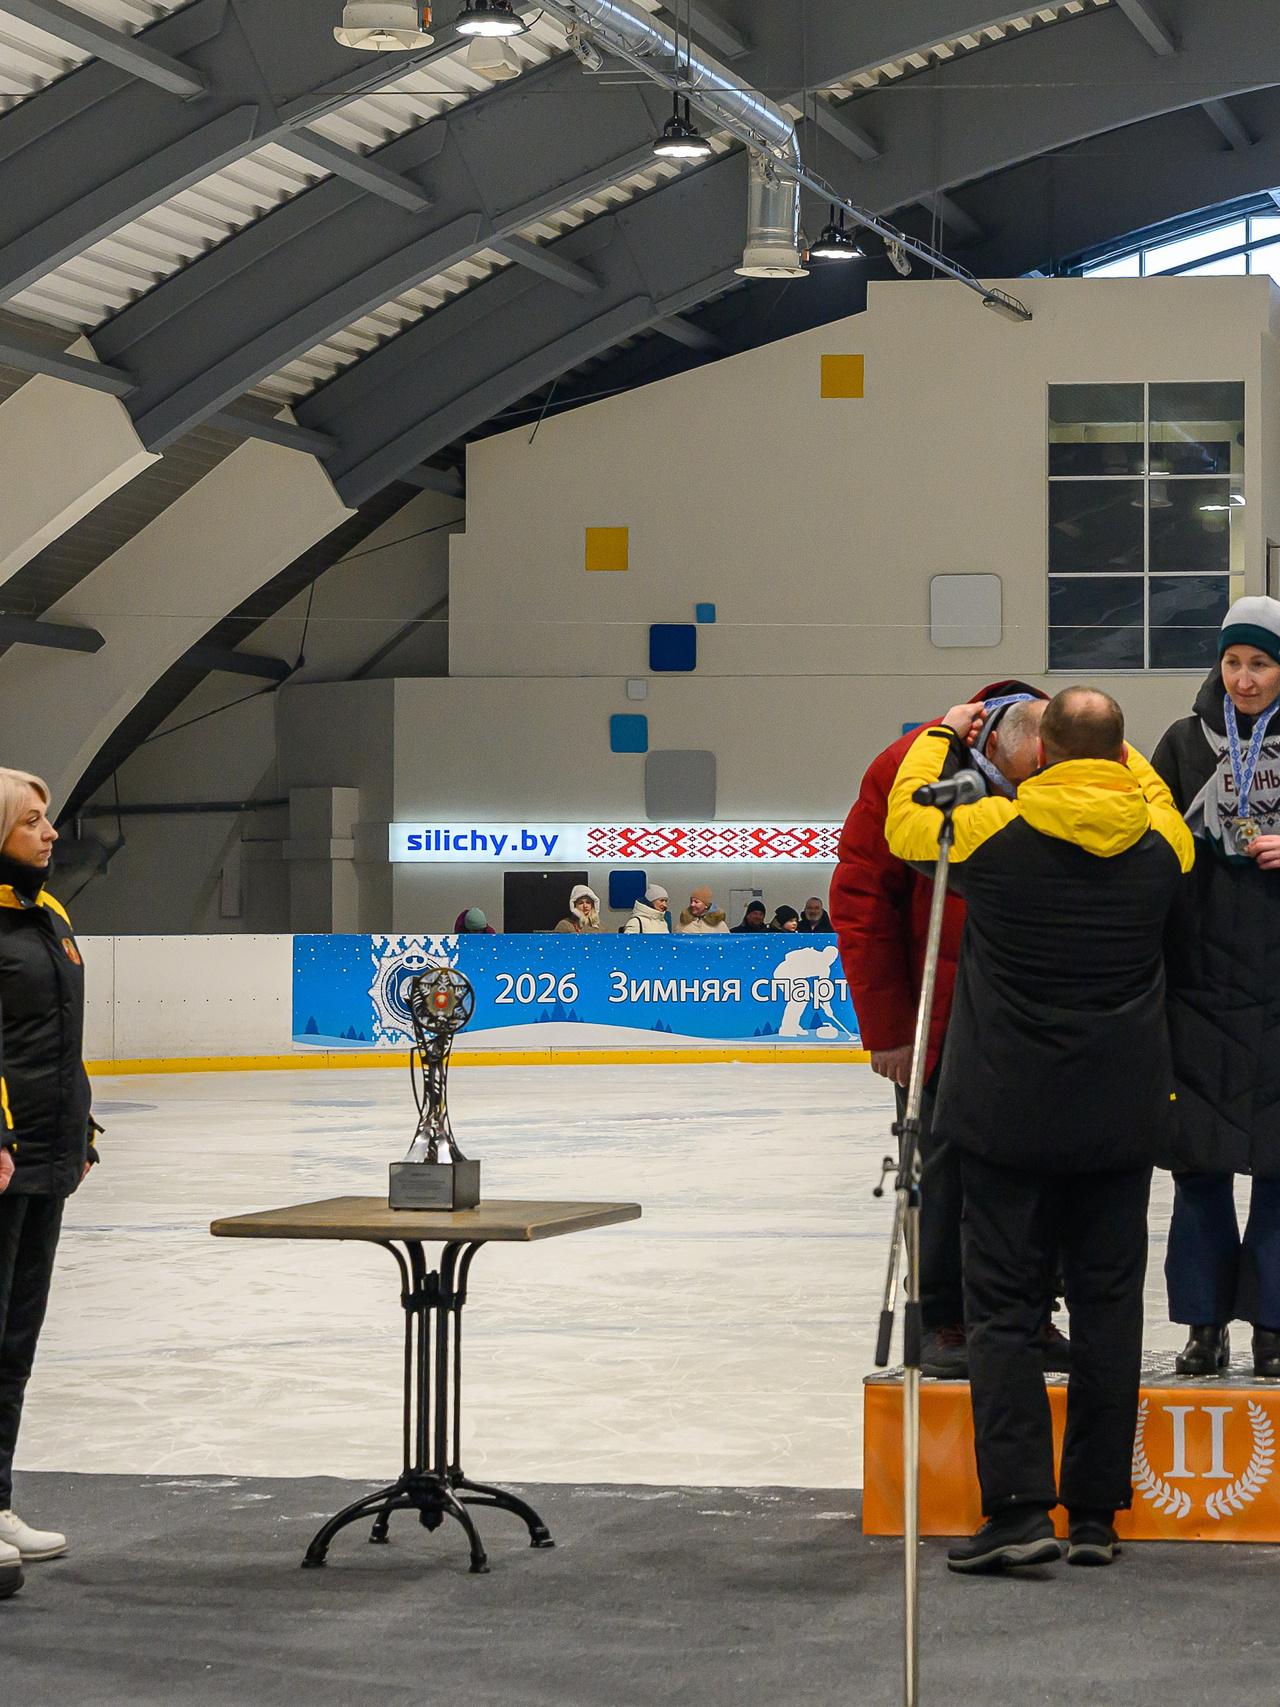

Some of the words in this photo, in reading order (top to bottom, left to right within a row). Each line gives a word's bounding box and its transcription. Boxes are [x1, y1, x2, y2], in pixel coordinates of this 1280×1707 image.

[407, 829, 559, 856] silichy.by
[495, 973, 579, 1003] 2026
[609, 972, 742, 1002] Зимняя
[1162, 1406, 1234, 1478] II
